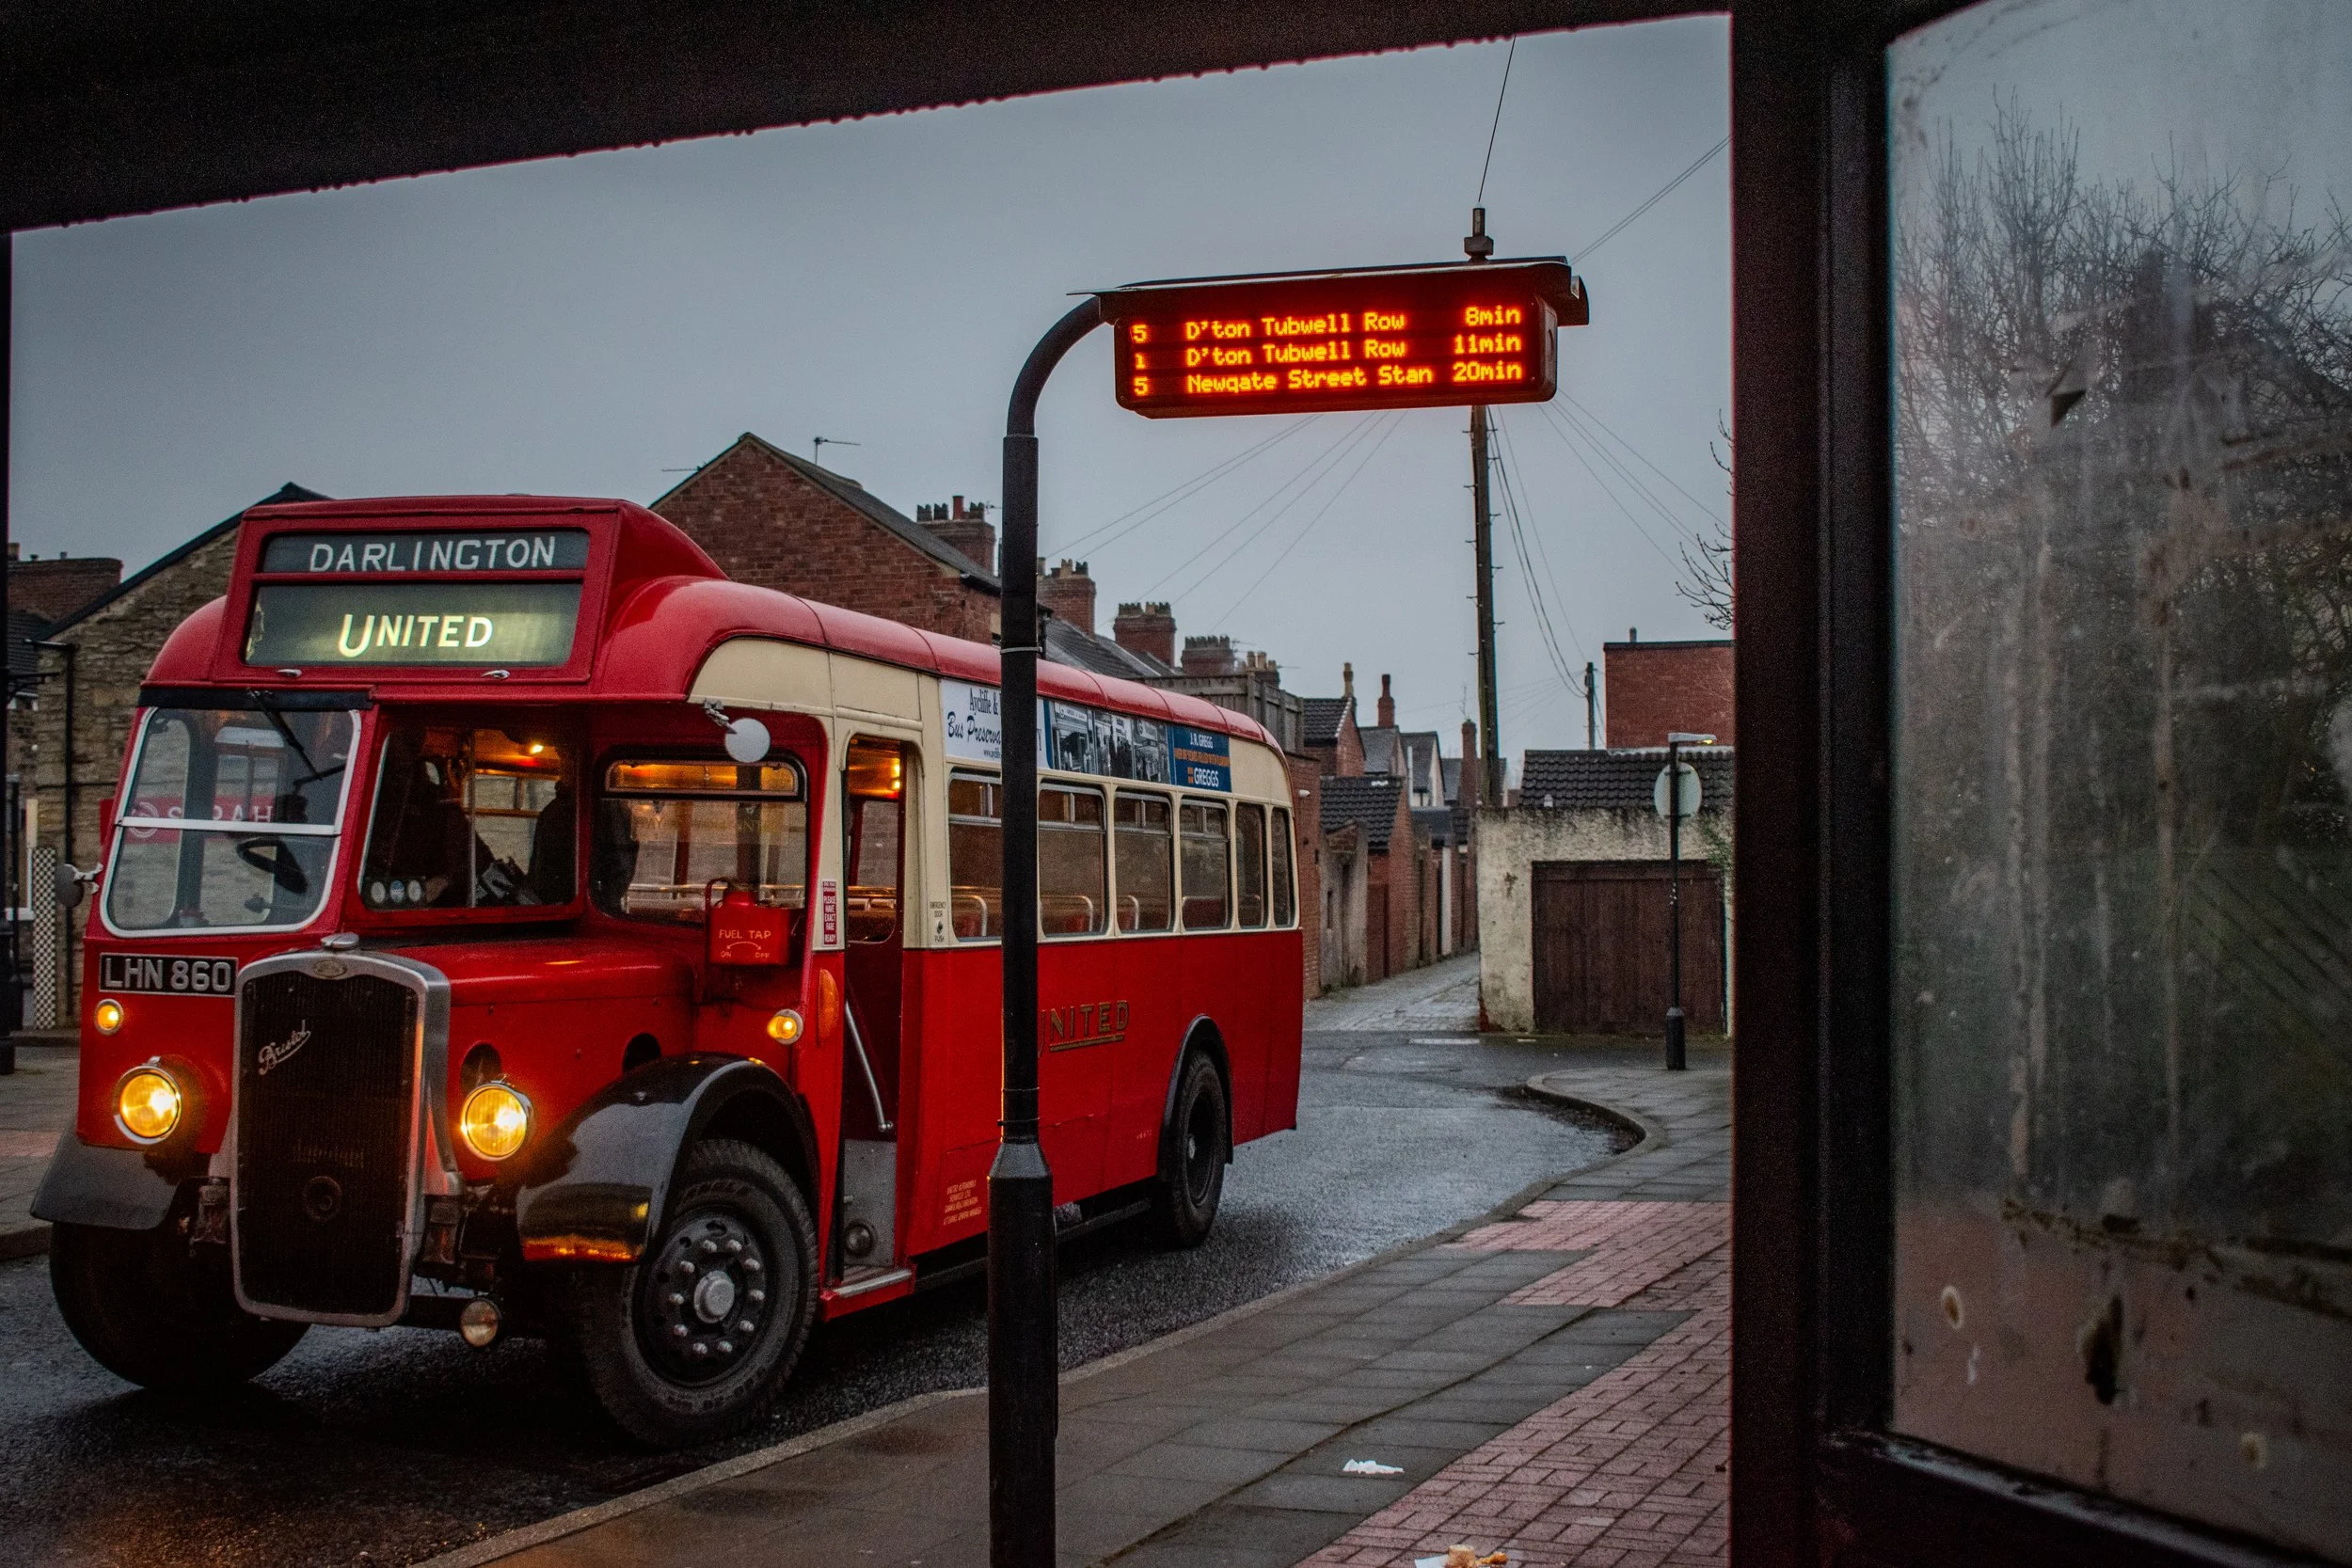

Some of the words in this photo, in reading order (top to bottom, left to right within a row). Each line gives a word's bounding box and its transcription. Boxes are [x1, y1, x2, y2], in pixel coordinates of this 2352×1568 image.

[1132, 324, 1148, 343] 5
[1185, 320, 1251, 341] D'ton
[1261, 314, 1350, 336] Tubwell
[1363, 312, 1406, 331] Row
[1465, 306, 1521, 326] 8min
[1135, 353, 1146, 370] 1
[1186, 347, 1252, 367] D'ton
[1262, 341, 1351, 363] Tubwell
[1364, 340, 1406, 358] Row
[1454, 333, 1522, 355] 11min
[1134, 376, 1149, 396] 5
[1288, 368, 1367, 389] Street
[1378, 365, 1433, 385] Stan
[1453, 360, 1522, 382] 20min
[310, 536, 555, 572] DARLINGTON
[338, 613, 494, 657] UNITED
[947, 711, 963, 738] Bus
[966, 715, 1002, 744] Preserva
[1194, 768, 1220, 788] GREGGS
[719, 929, 743, 940] FUEL
[749, 929, 771, 940] TAP
[721, 950, 732, 958] ON
[105, 958, 163, 990] LHN
[170, 960, 231, 992] 860
[259, 1019, 311, 1075] Bristol
